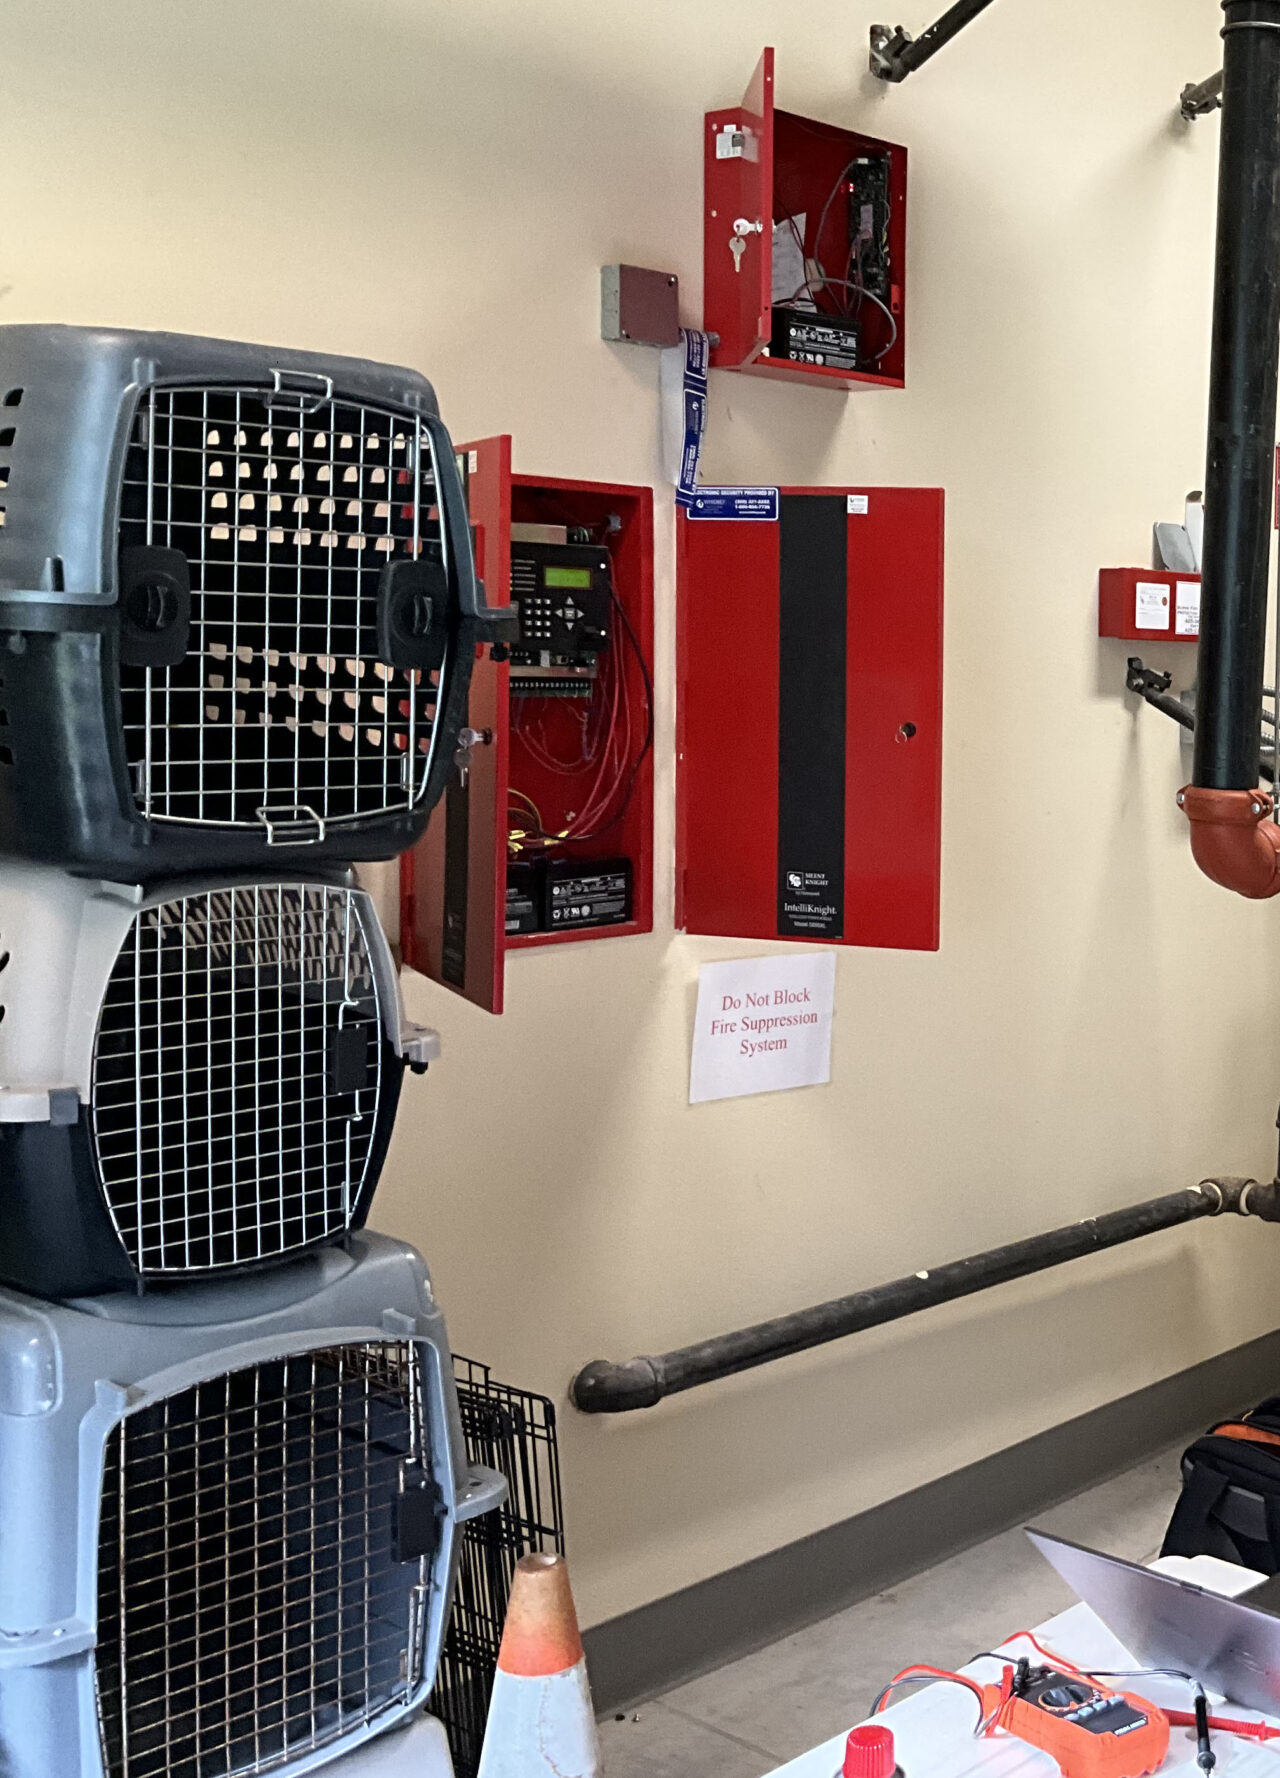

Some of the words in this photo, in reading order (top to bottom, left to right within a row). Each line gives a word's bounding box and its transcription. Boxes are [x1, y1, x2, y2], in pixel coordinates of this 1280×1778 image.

[722, 995, 741, 1011] Do
[746, 992, 770, 1008] Not
[774, 988, 811, 1005] Block
[710, 1019, 737, 1035] Fire
[740, 1010, 818, 1033] Suppression
[740, 1038, 787, 1058] System
